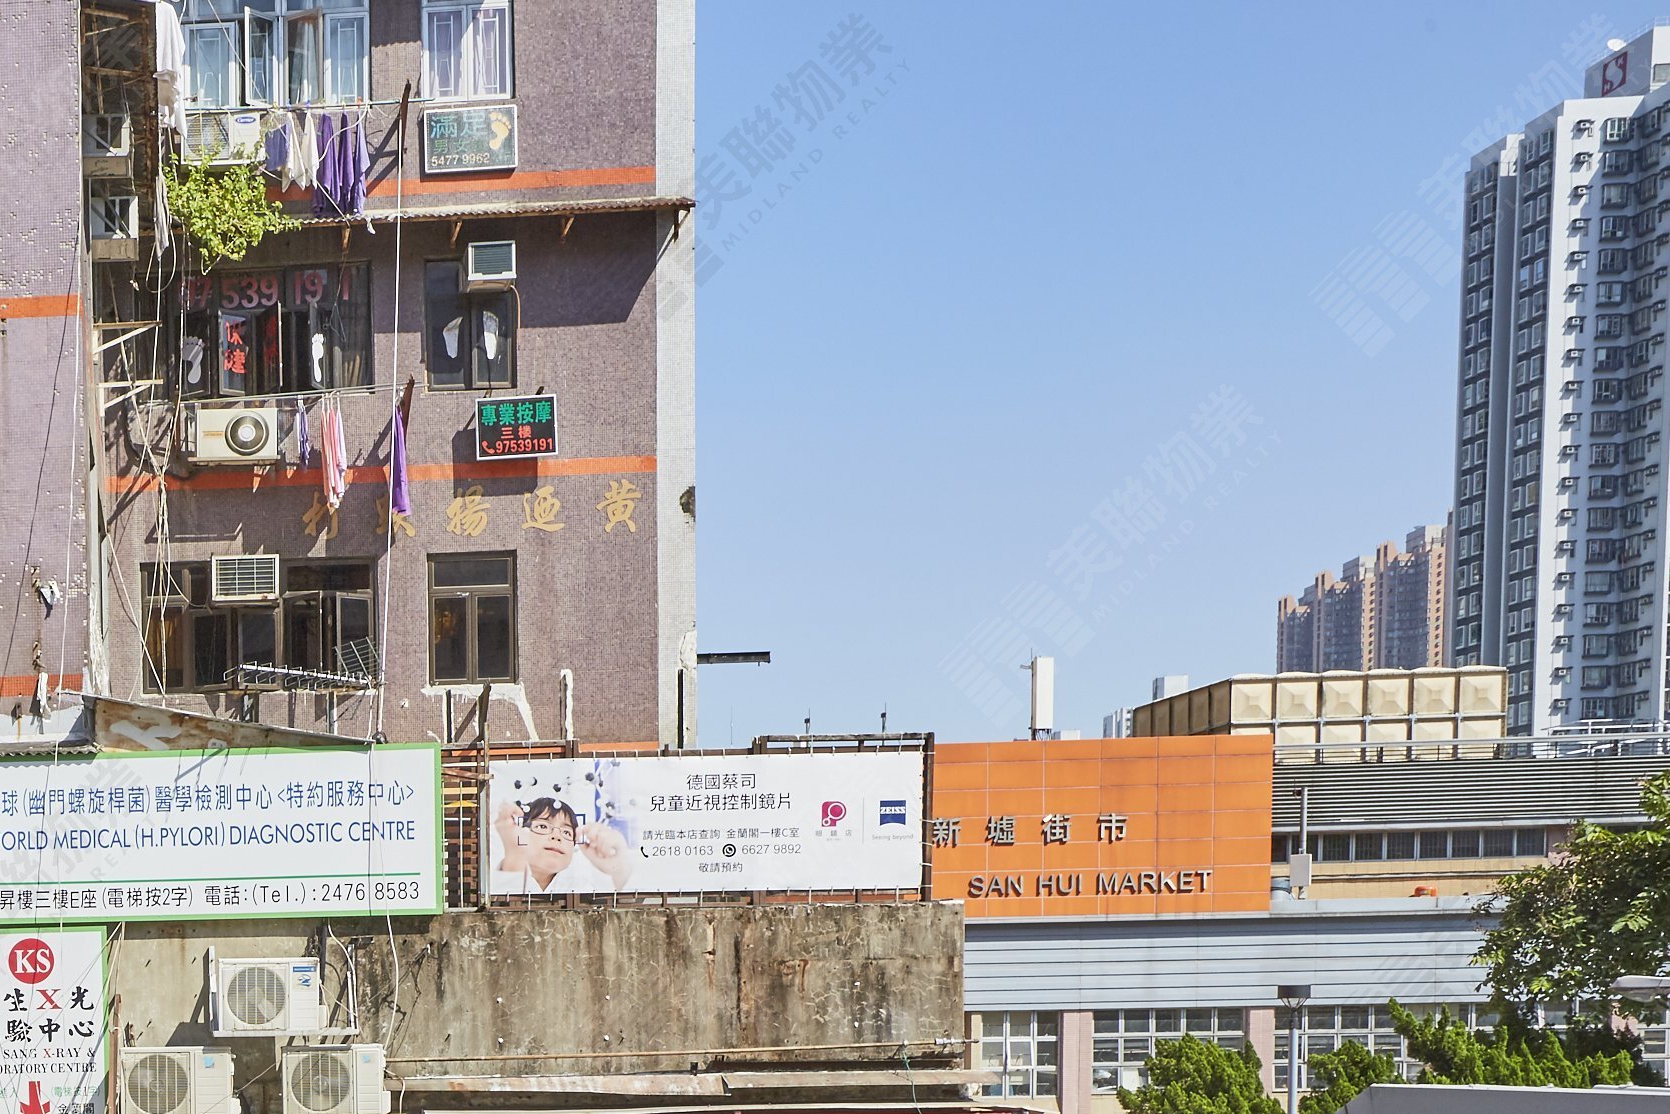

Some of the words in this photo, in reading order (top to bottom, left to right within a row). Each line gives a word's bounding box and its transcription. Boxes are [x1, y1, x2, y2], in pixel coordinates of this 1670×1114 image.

[481, 401, 552, 426] 專業按摩
[495, 438, 553, 453] 97539191
[686, 773, 756, 791] 德國蔡司
[650, 792, 791, 812] 兒童近視控制鏡片
[880, 806, 906, 814] ZEISS
[53, 826, 131, 849] MEDICAL
[134, 822, 226, 848] (H.PYLORI)
[229, 822, 342, 845] DIAGNOSTIC
[348, 821, 416, 842] CENTRE
[643, 829, 720, 840] 請光臨本店查詢
[726, 827, 799, 839] 金蘭閣一樓C室
[932, 813, 1128, 847] 新墟街市
[652, 846, 681, 856] 2618
[684, 845, 714, 856] 0163
[741, 844, 770, 855] 6627
[773, 843, 802, 854] 9892
[698, 862, 743, 873] 敬請預約
[374, 880, 421, 902] 8583
[968, 874, 1025, 897] SAN
[1036, 873, 1082, 896] HUI
[1095, 870, 1213, 894] MARKET
[14, 949, 51, 974] KS
[3, 1049, 38, 1060] SANG
[43, 1047, 81, 1059] X-RAY
[87, 1048, 95, 1057] &
[50, 1062, 97, 1073] CENTRE
